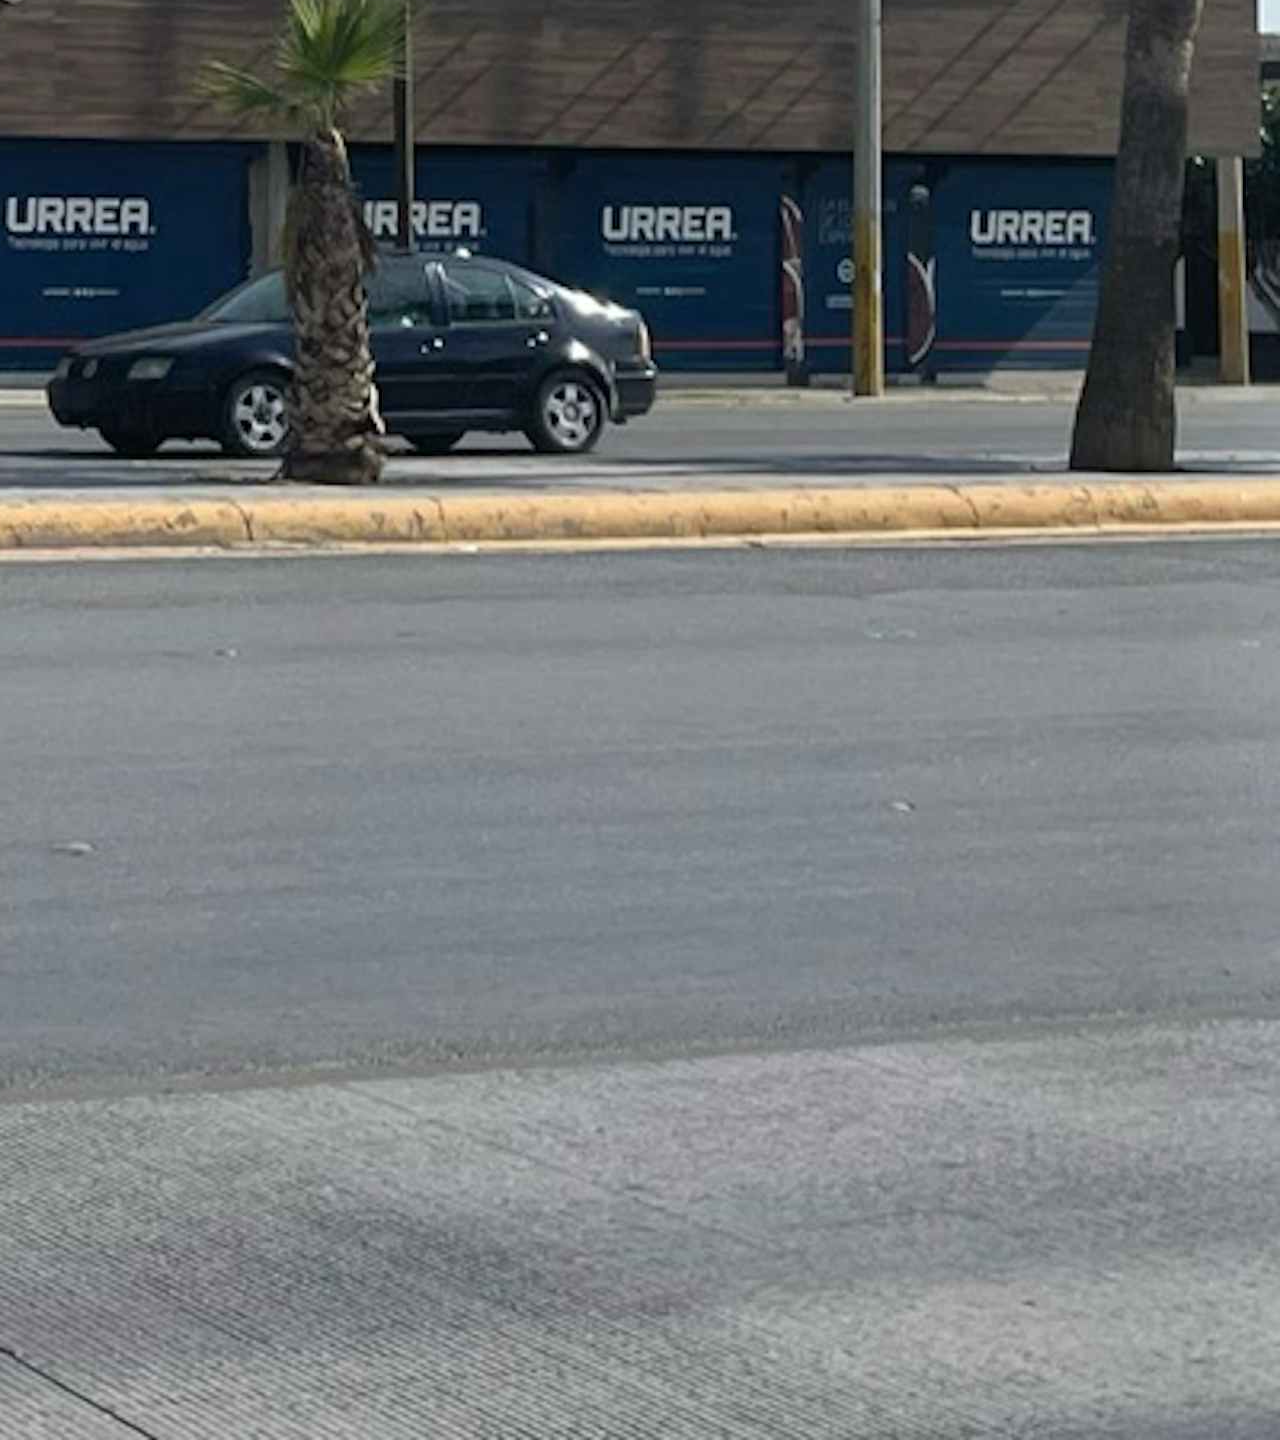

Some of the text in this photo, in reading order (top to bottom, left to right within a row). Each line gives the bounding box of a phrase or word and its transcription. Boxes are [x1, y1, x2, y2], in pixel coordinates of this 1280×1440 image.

[5, 196, 150, 235] URREA
[602, 205, 732, 241] URREA
[970, 209, 1093, 245] URREA
